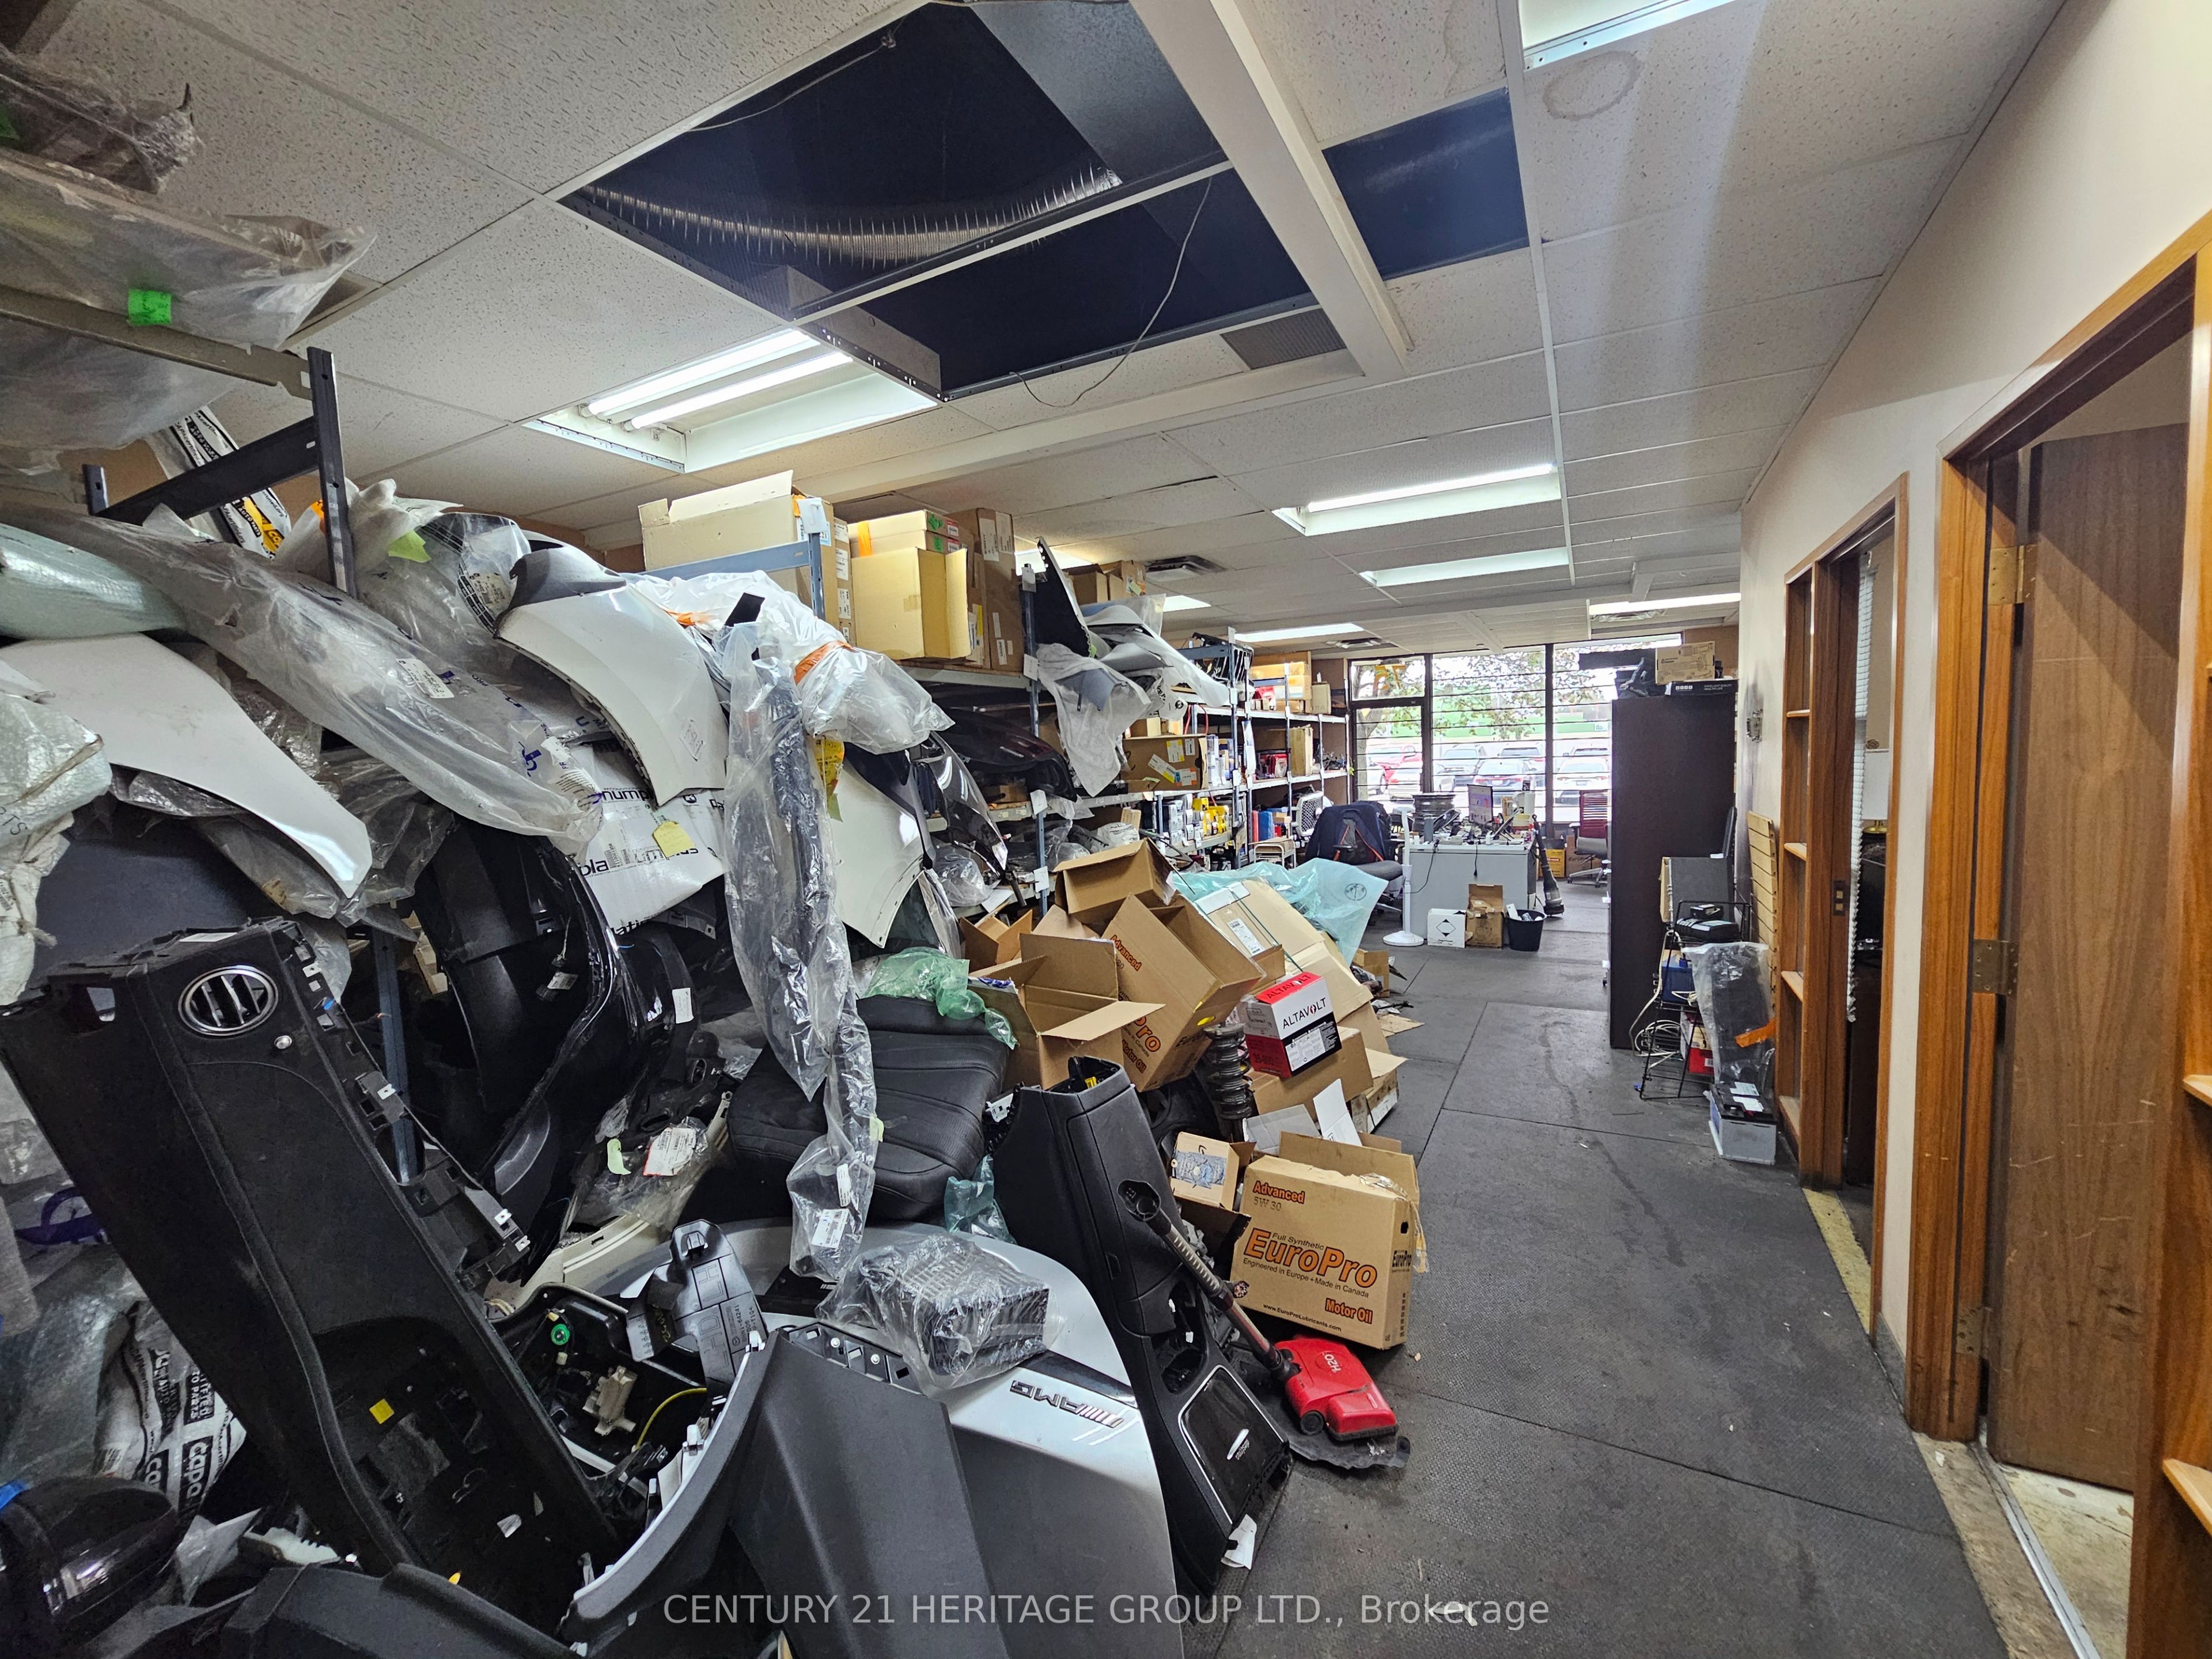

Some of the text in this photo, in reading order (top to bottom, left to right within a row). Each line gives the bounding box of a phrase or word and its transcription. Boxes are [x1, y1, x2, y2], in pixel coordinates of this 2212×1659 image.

[1110, 934, 1142, 972] Advanced
[1267, 974, 1312, 999] ALTAVOLT
[1282, 997, 1327, 1030] ALTAVOLT
[1135, 1058, 1147, 1074] Oil
[1252, 1180, 1305, 1205] Advanced
[1253, 1196, 1282, 1211] 5W 30
[1272, 1232, 1324, 1251] Full Synthetic
[1243, 1228, 1377, 1288] EuroPro
[1392, 1249, 1412, 1268] EuroPro
[1243, 1257, 1278, 1273] Engineered
[1278, 1266, 1285, 1275] in
[1286, 1269, 1309, 1282] Europe
[1334, 1282, 1342, 1290] in
[1343, 1285, 1369, 1298] Canada
[1263, 1303, 1342, 1332] www.EuroProLubricants.com
[1324, 1297, 1373, 1325] Motor Oil
[1010, 1380, 1086, 1415] AMG
[189, 1441, 208, 1500] capa
